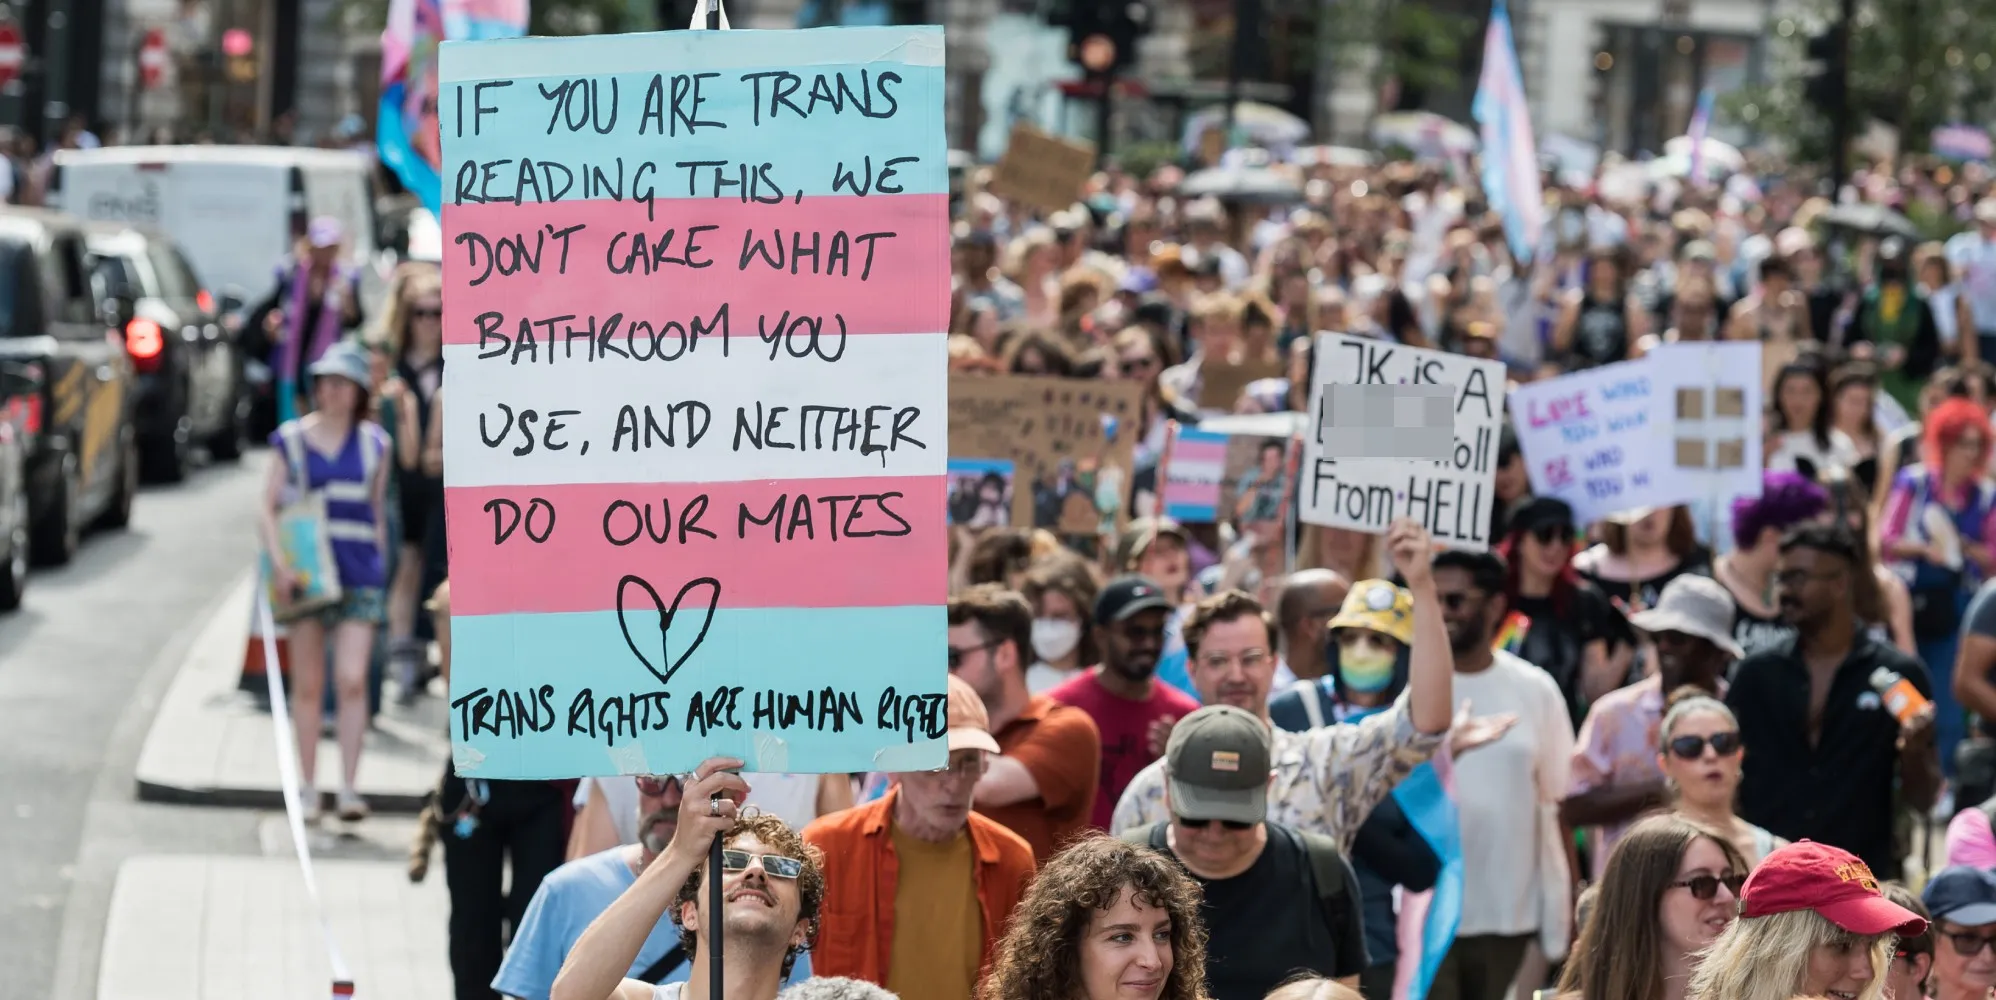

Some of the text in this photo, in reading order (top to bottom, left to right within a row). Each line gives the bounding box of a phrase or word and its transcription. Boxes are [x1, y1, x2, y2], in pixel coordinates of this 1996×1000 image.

[456, 68, 903, 138] IF YOU ARE TRANS
[454, 155, 920, 222] READING THIS, WE
[454, 223, 897, 287] DON'T CARE WHAT
[473, 302, 847, 366] BATHROOM YOU
[1456, 367, 1493, 418] A
[479, 403, 590, 457] USE,
[612, 400, 711, 453] AND
[732, 400, 927, 468] NEITHER
[483, 491, 912, 547] DO OUR MATES
[1312, 458, 1482, 542] From HELL
[451, 684, 555, 742] TRANS
[567, 688, 671, 748] RIGHTS
[685, 685, 745, 738] ARE
[752, 685, 864, 734] HUMAN
